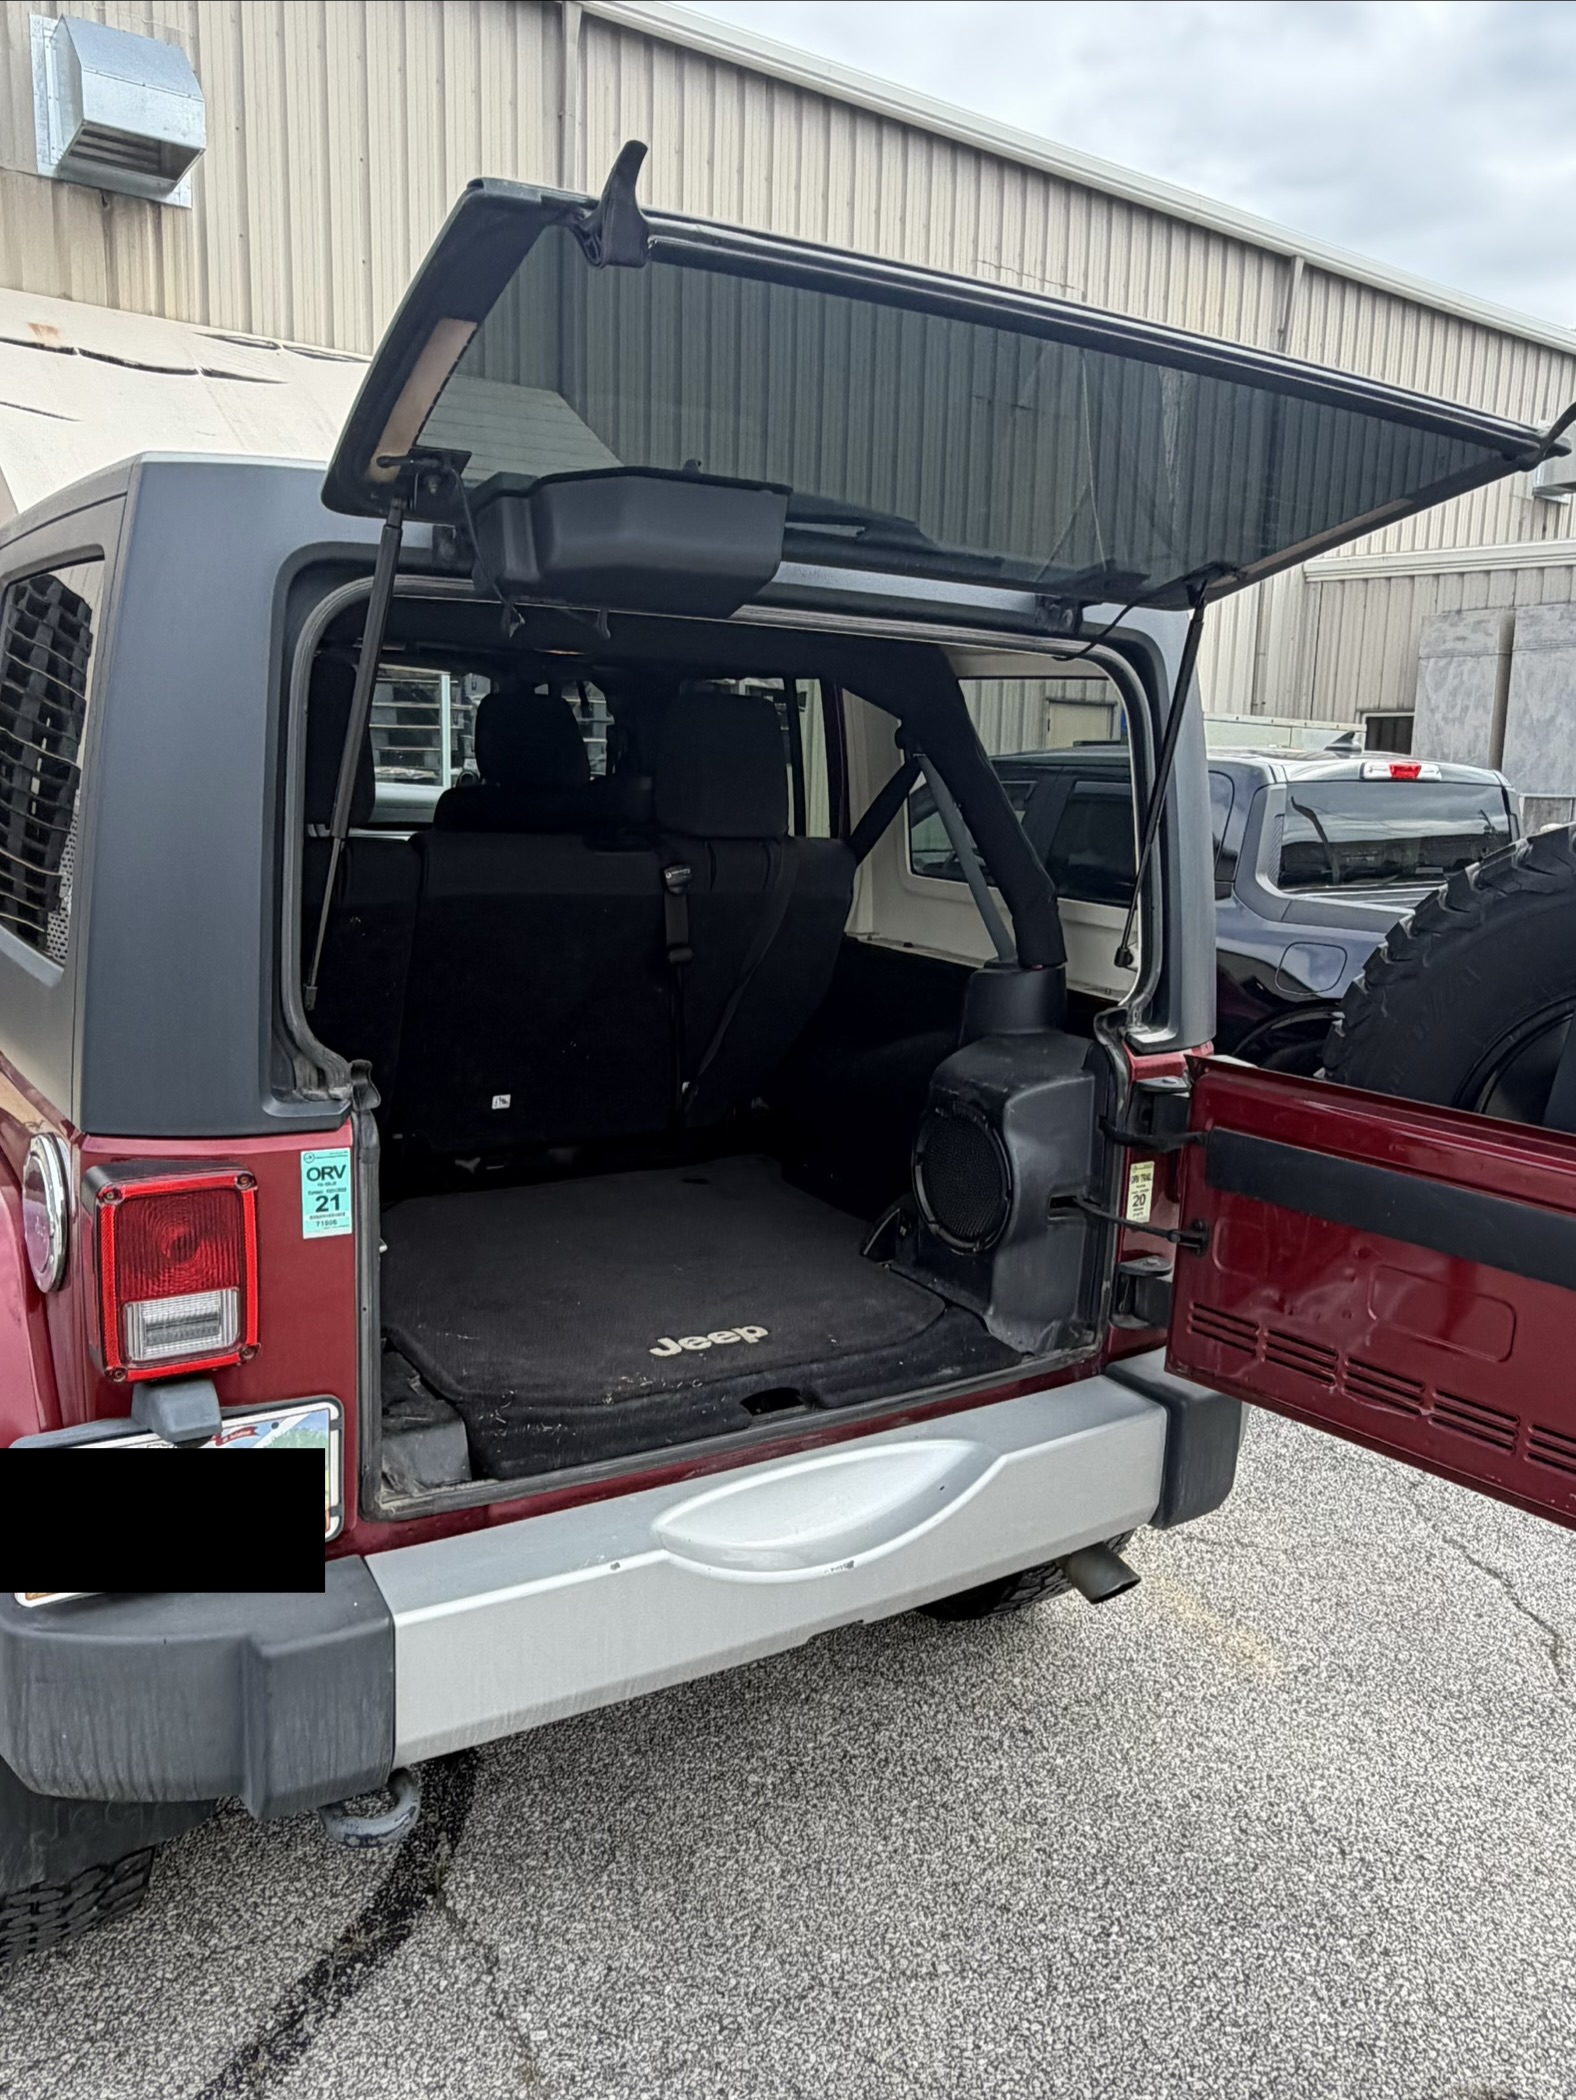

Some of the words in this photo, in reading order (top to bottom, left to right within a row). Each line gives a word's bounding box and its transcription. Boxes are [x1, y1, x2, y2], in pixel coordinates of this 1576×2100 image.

[306, 1164, 346, 1181] ORV
[315, 1193, 340, 1213] 21
[1132, 1194, 1146, 1207] 20
[649, 1325, 769, 1357] Jeep
